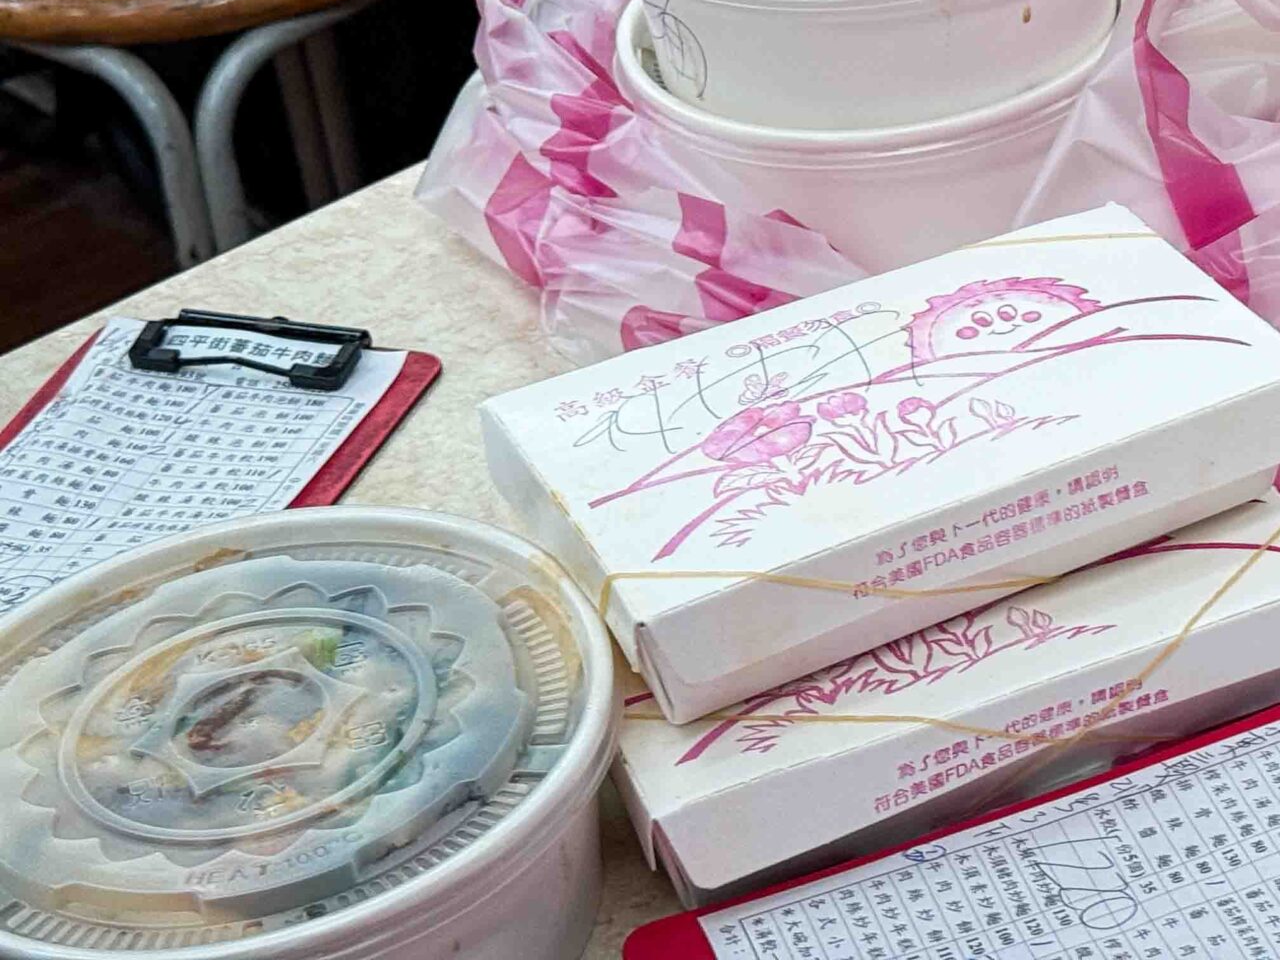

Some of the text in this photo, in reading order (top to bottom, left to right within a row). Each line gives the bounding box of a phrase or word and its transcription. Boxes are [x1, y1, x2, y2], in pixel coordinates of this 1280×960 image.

[1250, 839, 1267, 853] 80
[1221, 848, 1241, 867] 130
[1195, 860, 1212, 874] 80
[1168, 870, 1184, 883] 80
[1138, 880, 1157, 894] 35
[1052, 908, 1073, 926] 130
[1023, 917, 1043, 936] 120
[995, 927, 1014, 945] 100
[965, 936, 985, 955] 120
